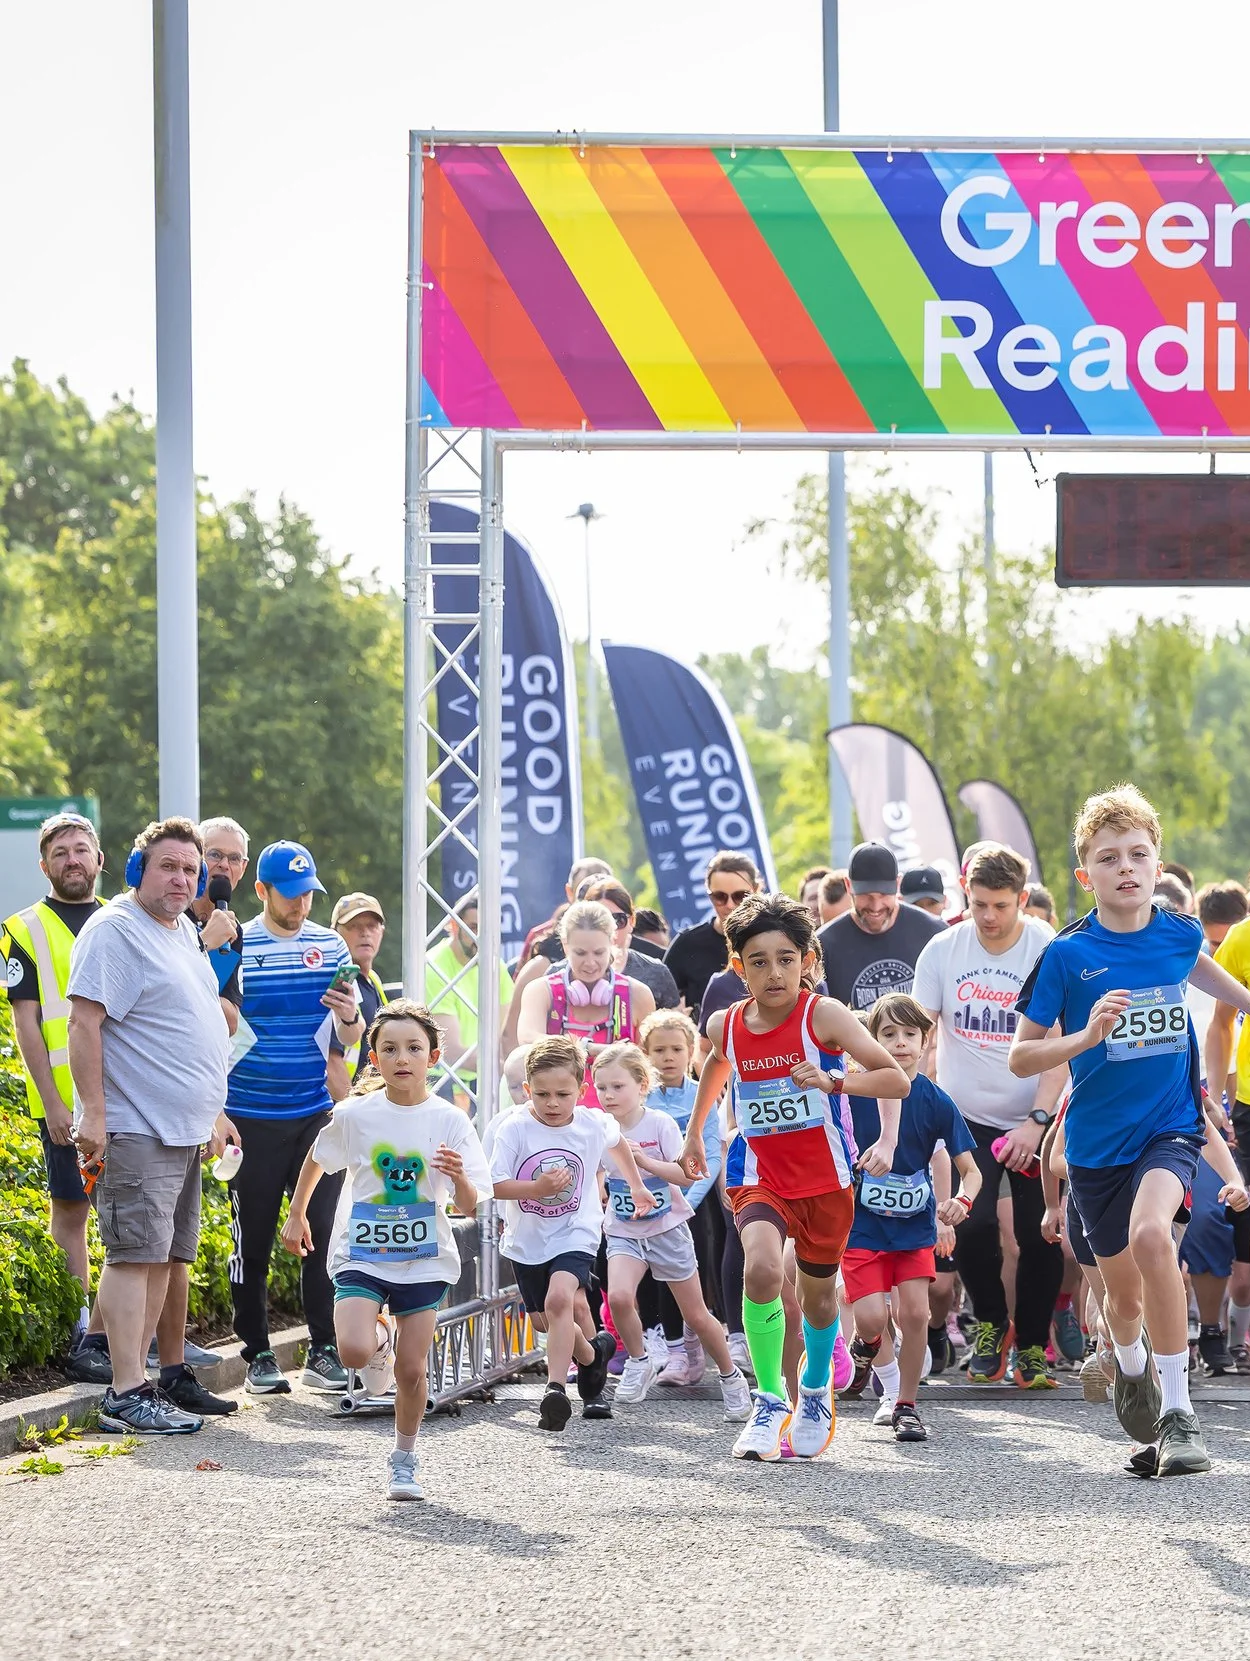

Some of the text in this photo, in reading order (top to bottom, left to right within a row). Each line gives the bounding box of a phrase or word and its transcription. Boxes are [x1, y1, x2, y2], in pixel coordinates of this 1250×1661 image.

[519, 654, 563, 835] GOOD
[700, 743, 757, 863] GOO
[635, 755, 693, 931] EVENTS
[955, 967, 1025, 987] BANK OF AMERIC
[1111, 1006, 1185, 1040] 2598
[742, 1052, 800, 1071] READING
[748, 1094, 811, 1125] 2561
[614, 1191, 665, 1213] 256
[355, 1220, 428, 1244] 2560
